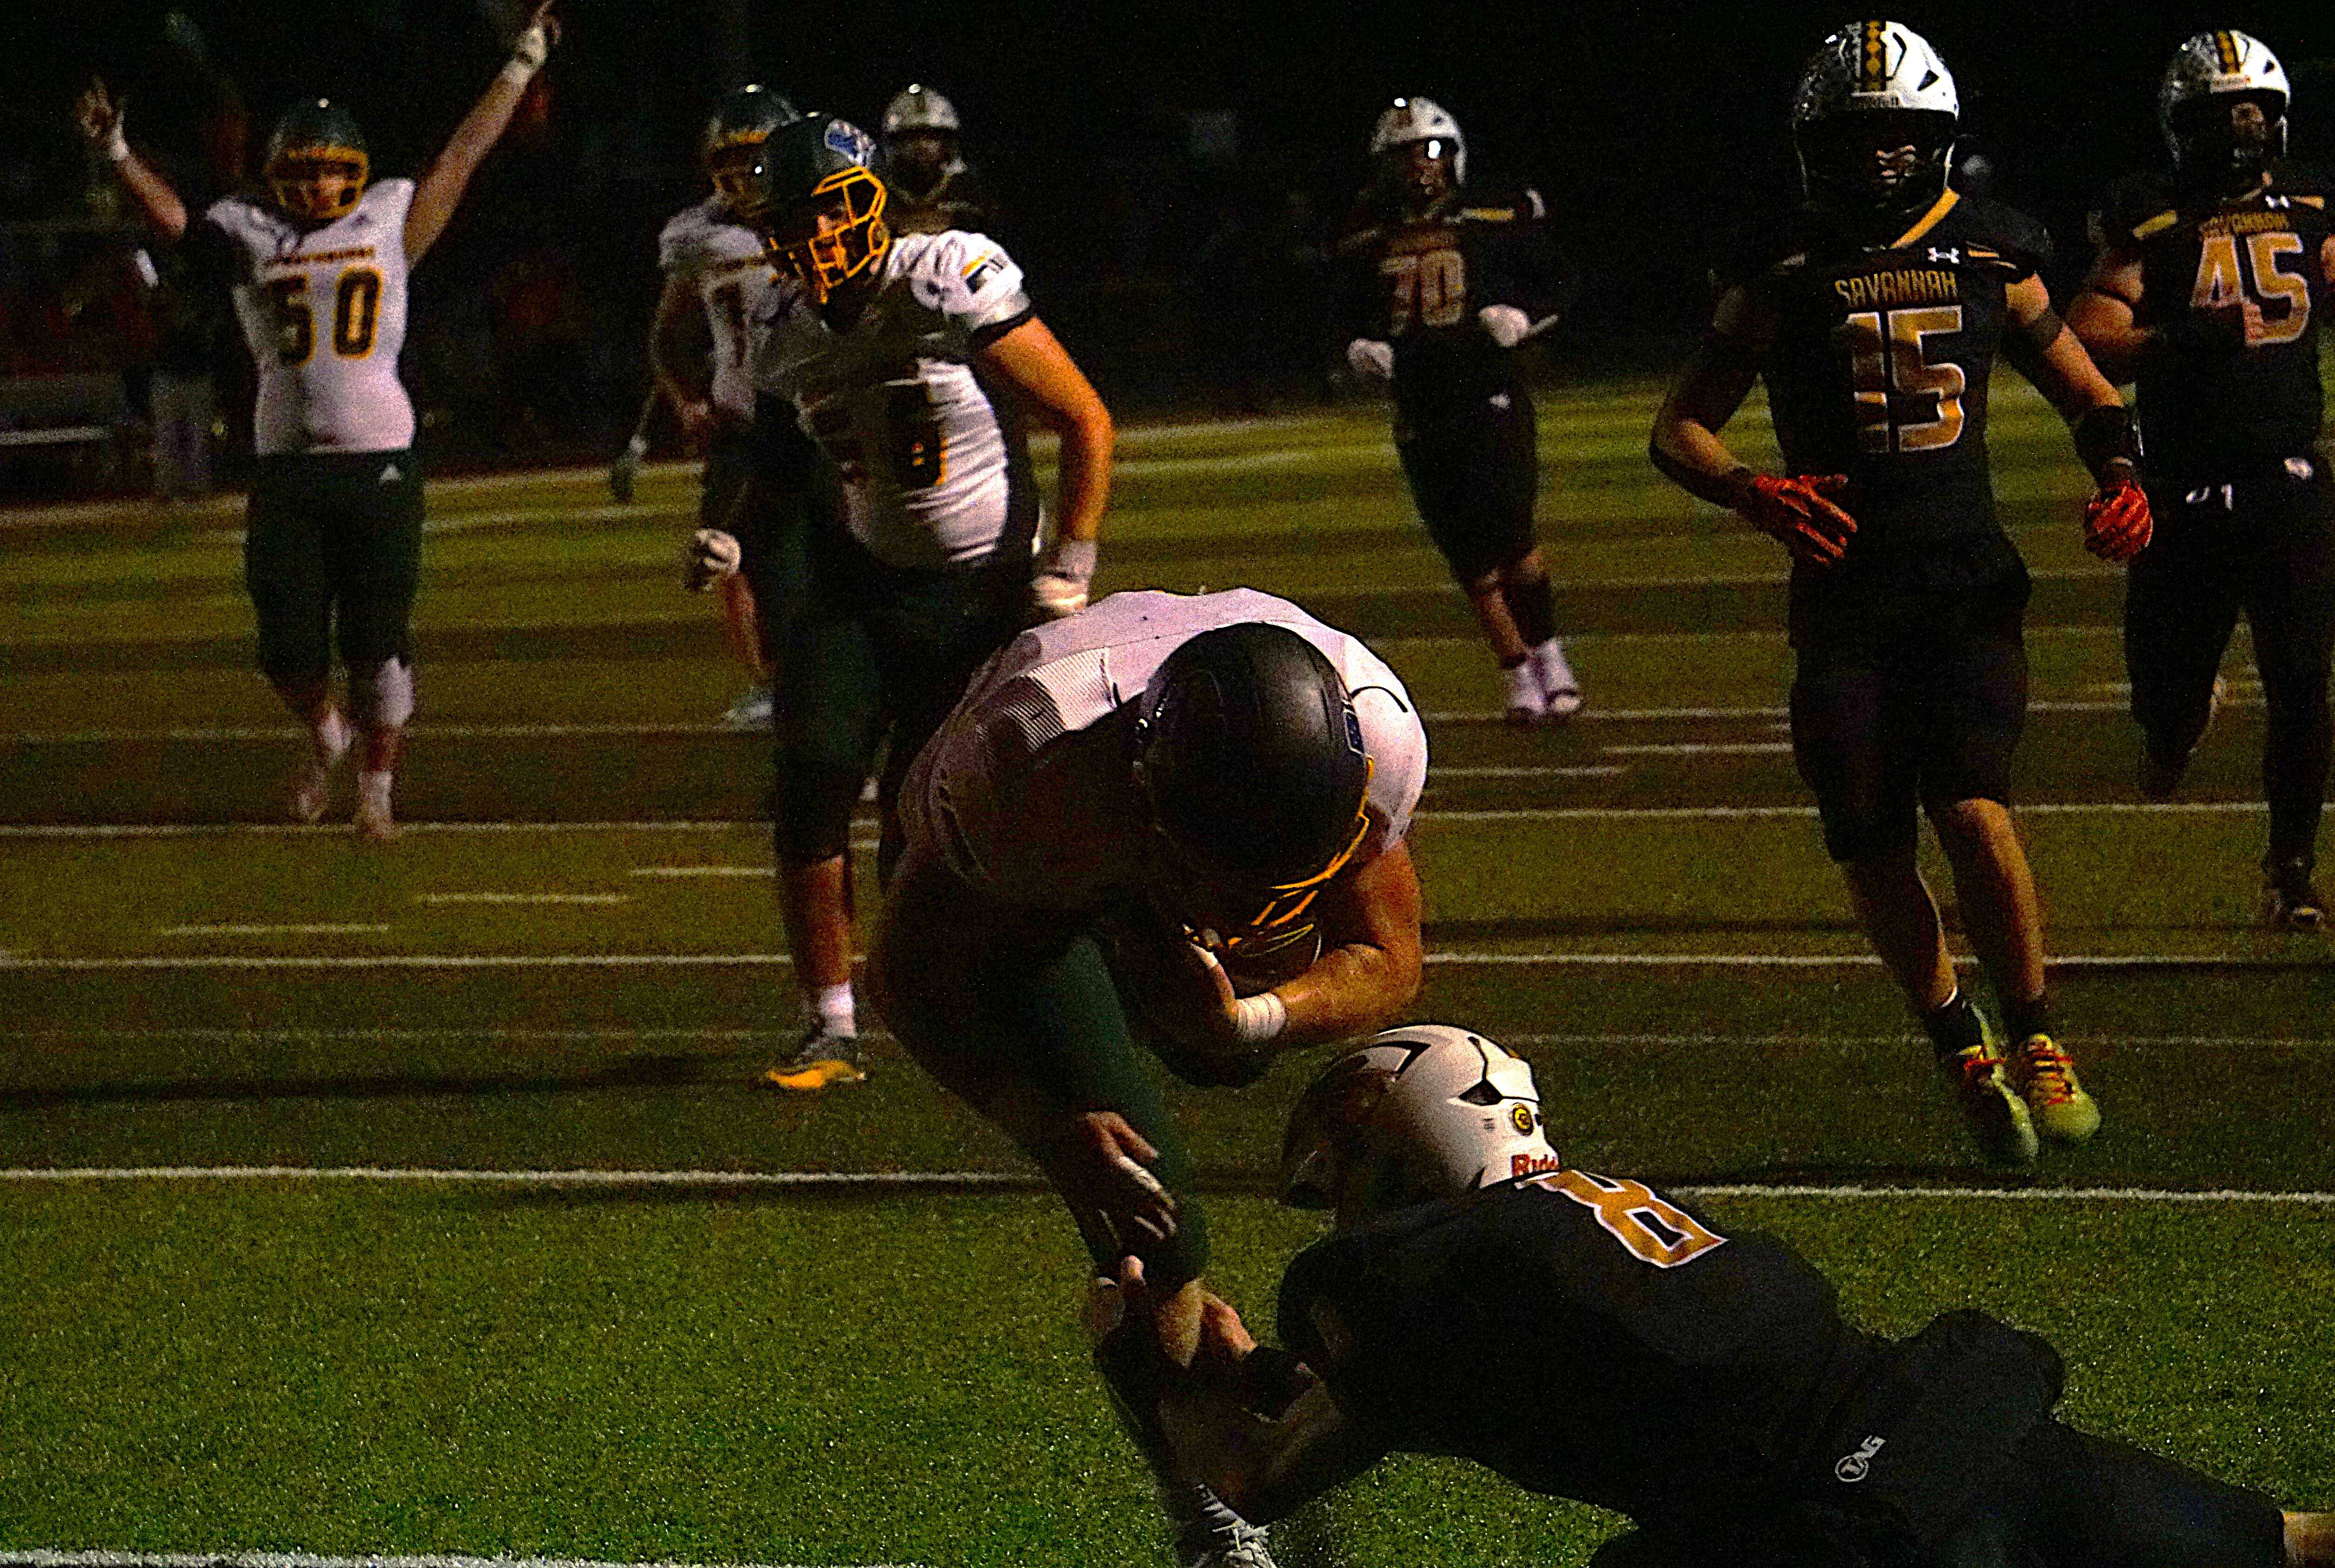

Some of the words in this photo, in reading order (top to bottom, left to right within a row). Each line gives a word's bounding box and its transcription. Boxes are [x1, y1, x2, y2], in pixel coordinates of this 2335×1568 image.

[262, 268, 382, 369] 50
[1834, 269, 1960, 307] SAVANNAH
[2190, 231, 2312, 346] 45
[1845, 304, 1967, 453] 15
[1514, 1169, 1729, 1268] 8
